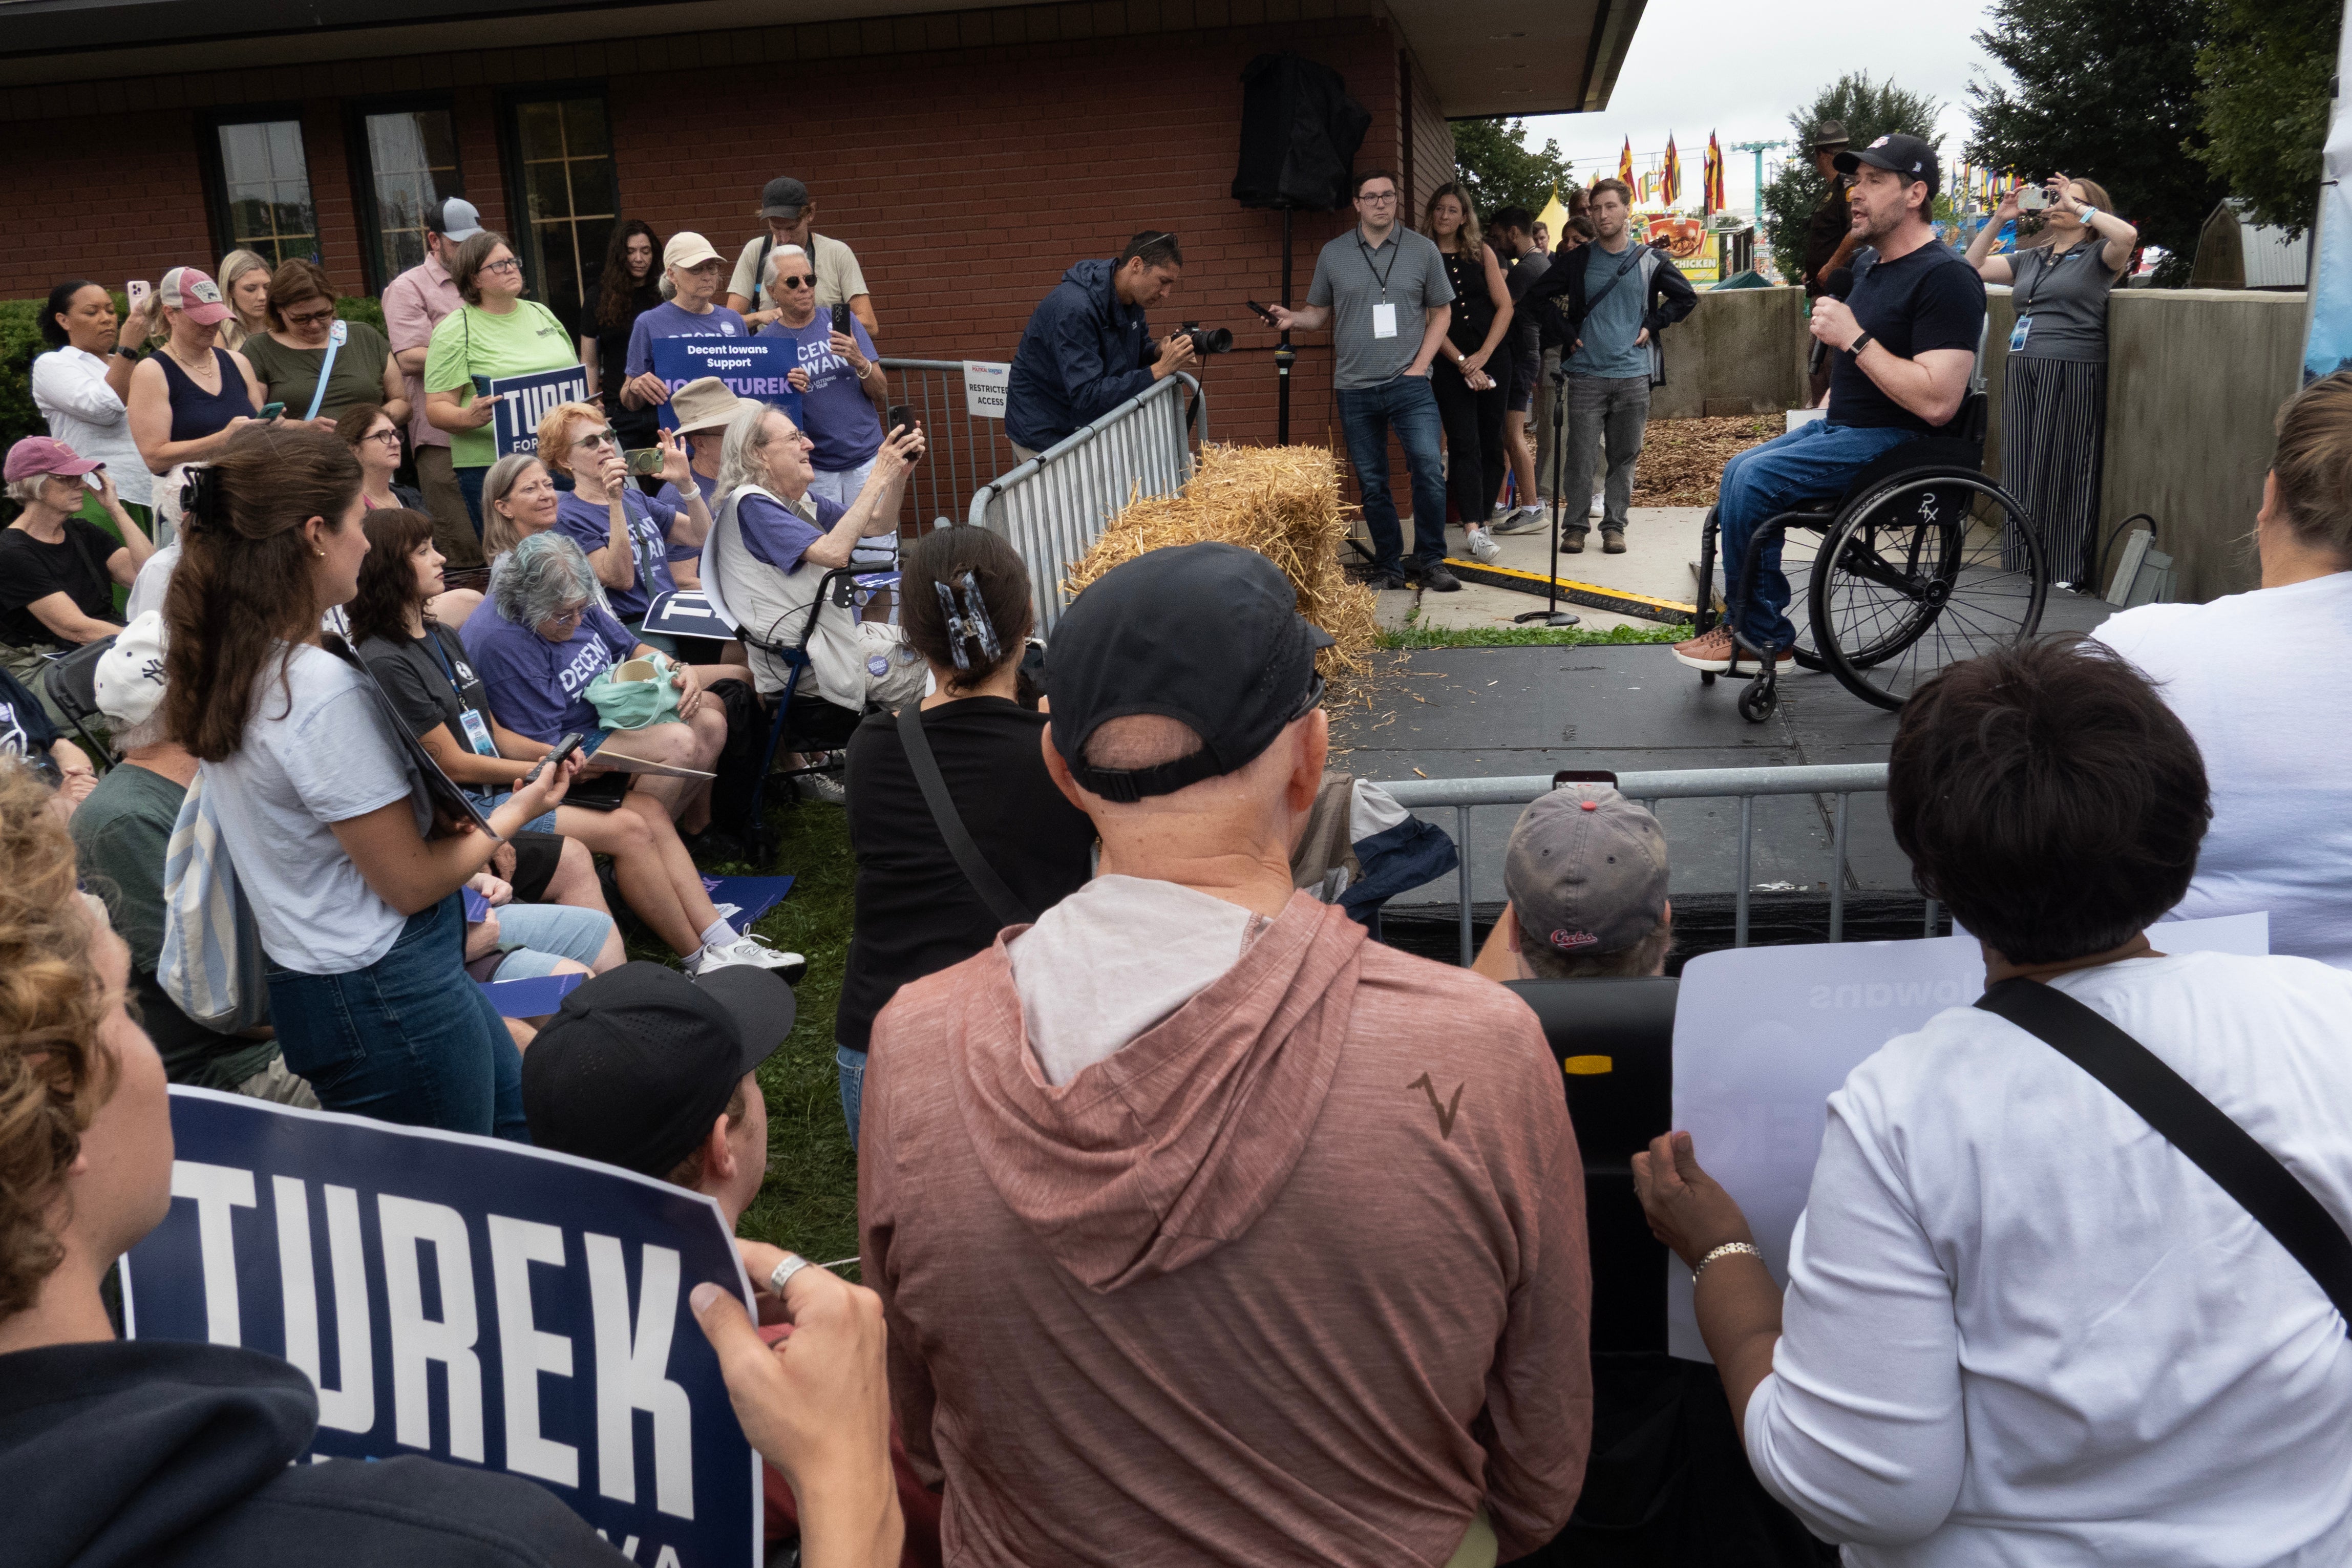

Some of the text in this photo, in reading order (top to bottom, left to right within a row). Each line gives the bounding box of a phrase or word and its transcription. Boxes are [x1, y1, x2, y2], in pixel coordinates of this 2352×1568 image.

[687, 345, 768, 354] Decent Iowans
[797, 339, 833, 363] CEN
[707, 358, 752, 370] Support
[724, 377, 793, 395] TUREK
[813, 375, 837, 386] LISTENING
[978, 396, 1004, 406] ACCESS
[169, 1160, 694, 1520] TUREK
